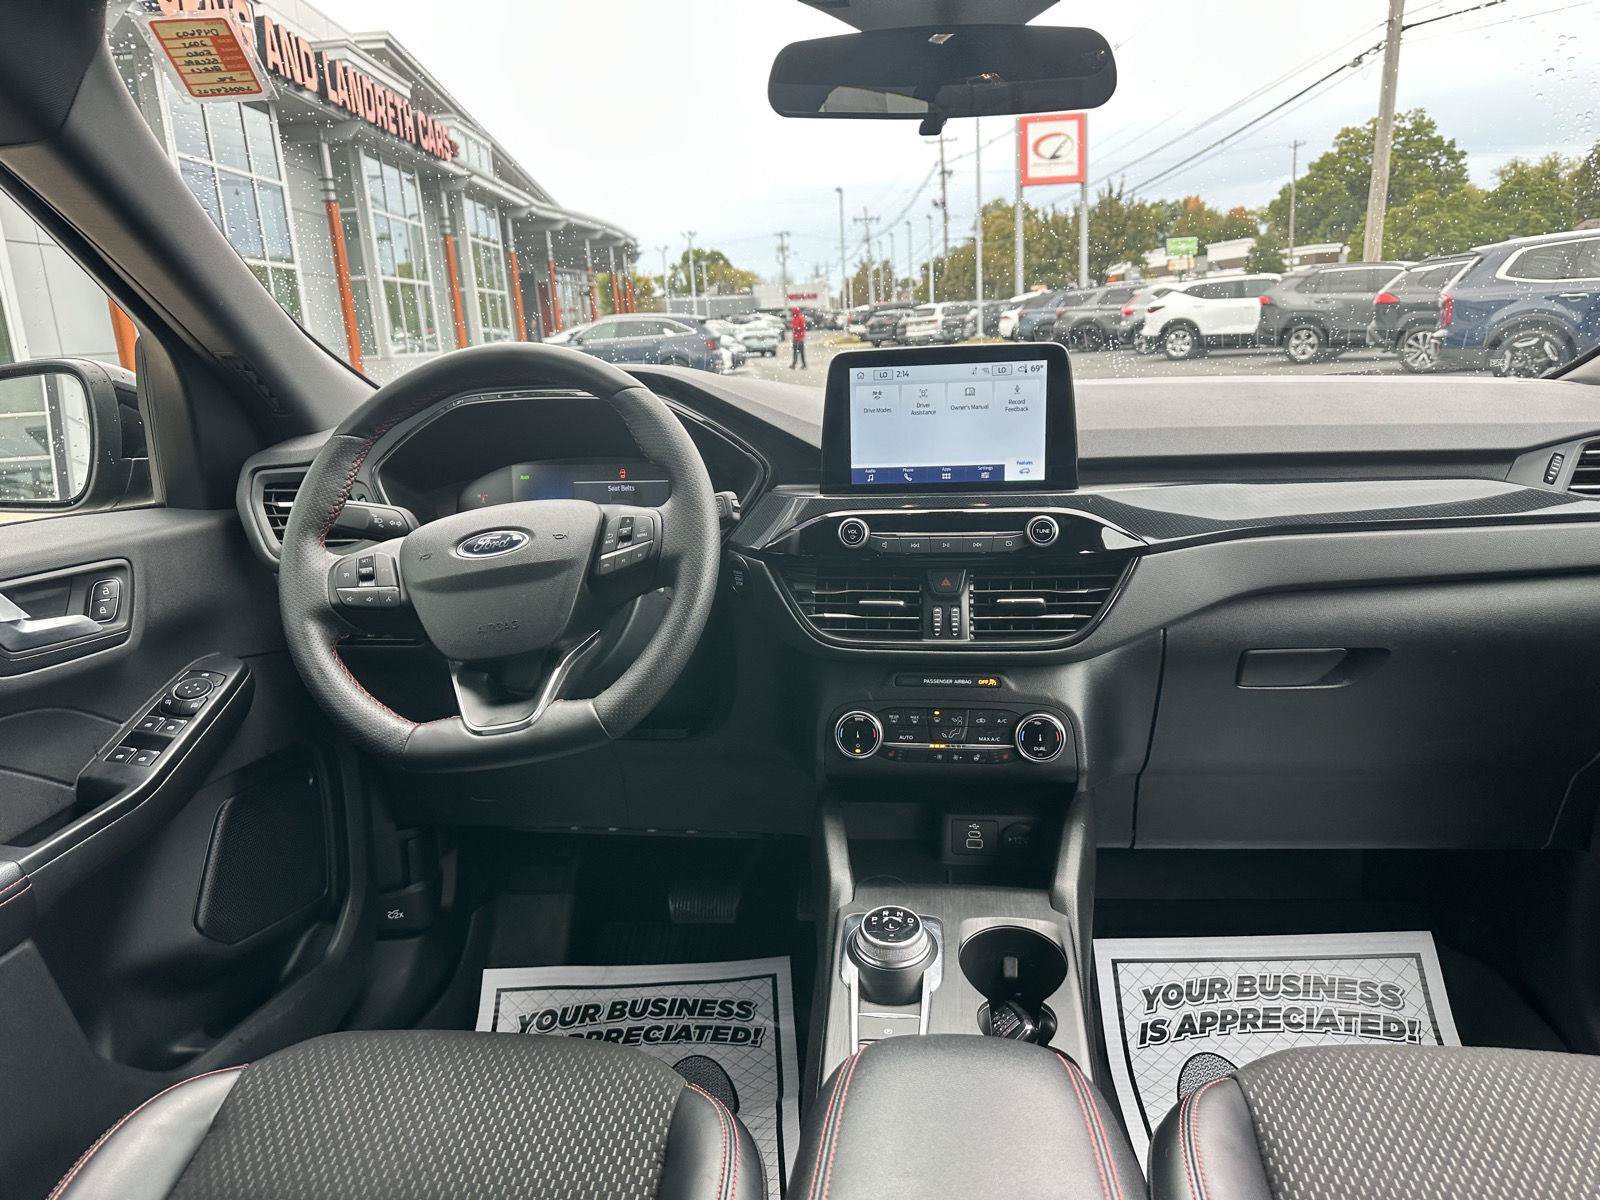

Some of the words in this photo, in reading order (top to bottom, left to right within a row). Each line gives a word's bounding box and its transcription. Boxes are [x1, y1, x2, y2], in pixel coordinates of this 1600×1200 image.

[262, 16, 319, 92] AND
[321, 51, 416, 144] LANDRETH
[417, 111, 453, 161] CARS
[896, 370, 910, 378] 2:14
[1140, 976, 1231, 1014] YOUR
[1235, 973, 1405, 1010] BUSINESS
[517, 1001, 603, 1034] YOUR
[605, 996, 758, 1022] BUSINESS
[1137, 1018, 1171, 1048] IS
[1171, 1006, 1421, 1044] APPRECIATED!
[562, 1024, 766, 1047] PRECIATED!
